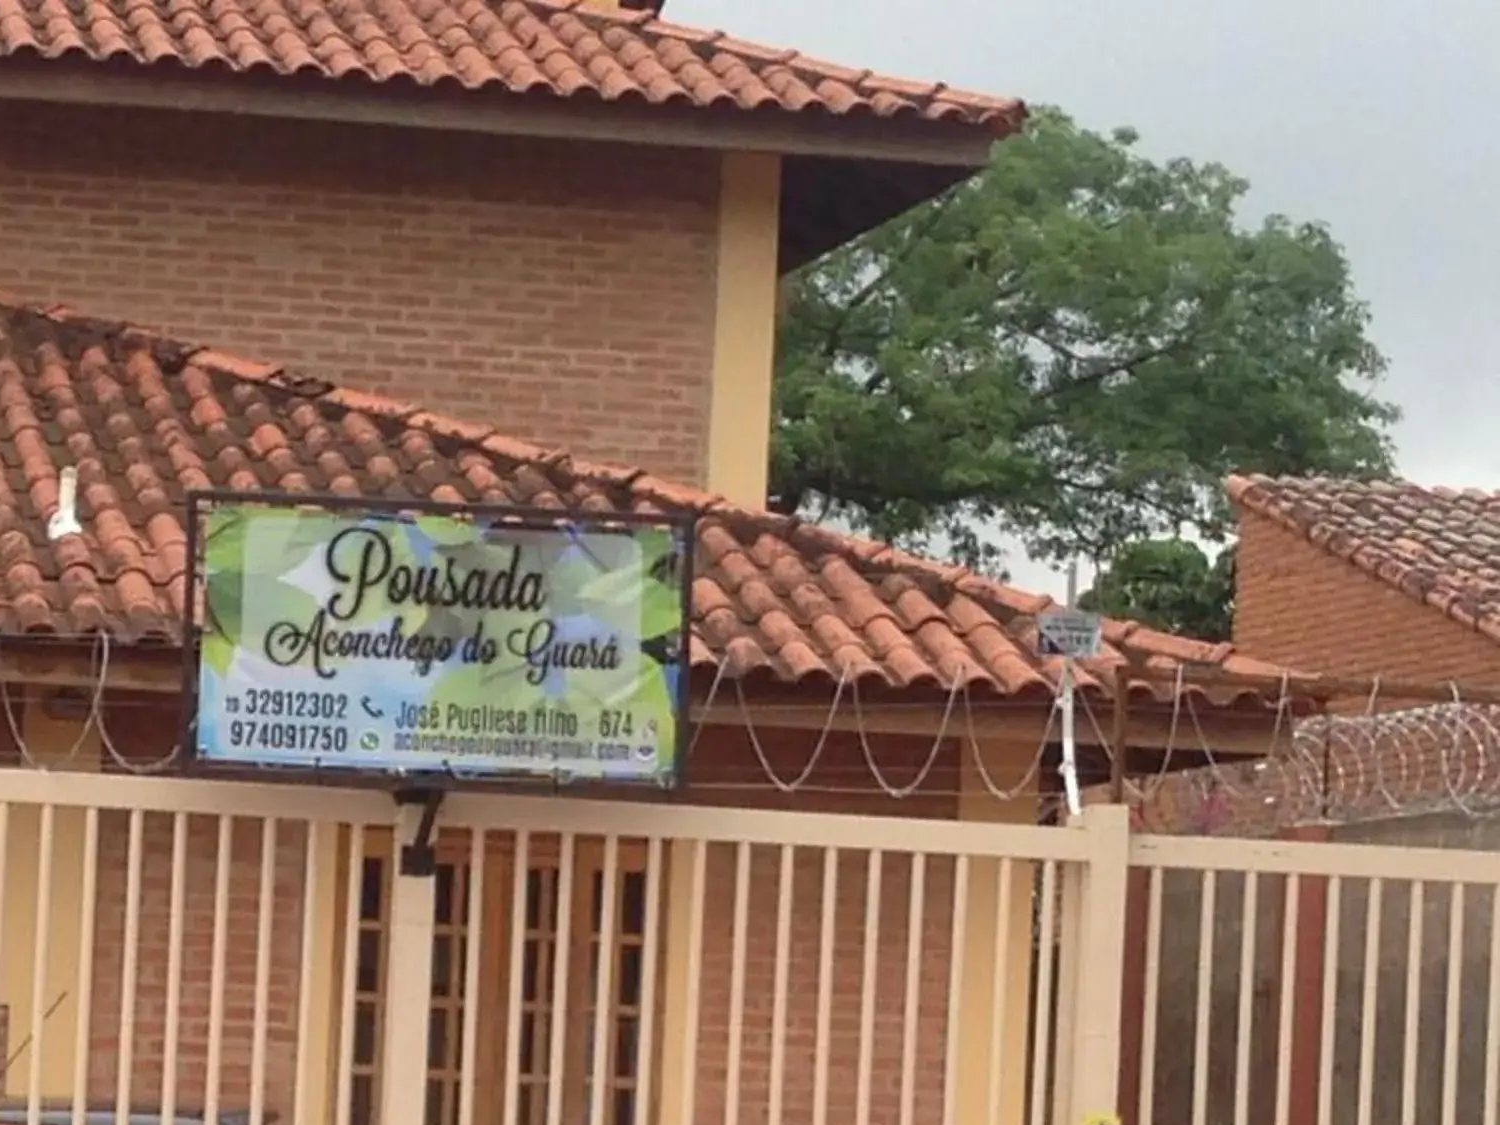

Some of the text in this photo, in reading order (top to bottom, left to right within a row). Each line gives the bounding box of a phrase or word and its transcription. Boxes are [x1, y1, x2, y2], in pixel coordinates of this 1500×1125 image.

[326, 527, 547, 620] Pousada
[265, 609, 622, 685] Aconchego do Guará
[245, 688, 349, 719] 32912302
[394, 700, 440, 729] José
[598, 709, 633, 738] 674
[230, 720, 349, 752] 974091750
